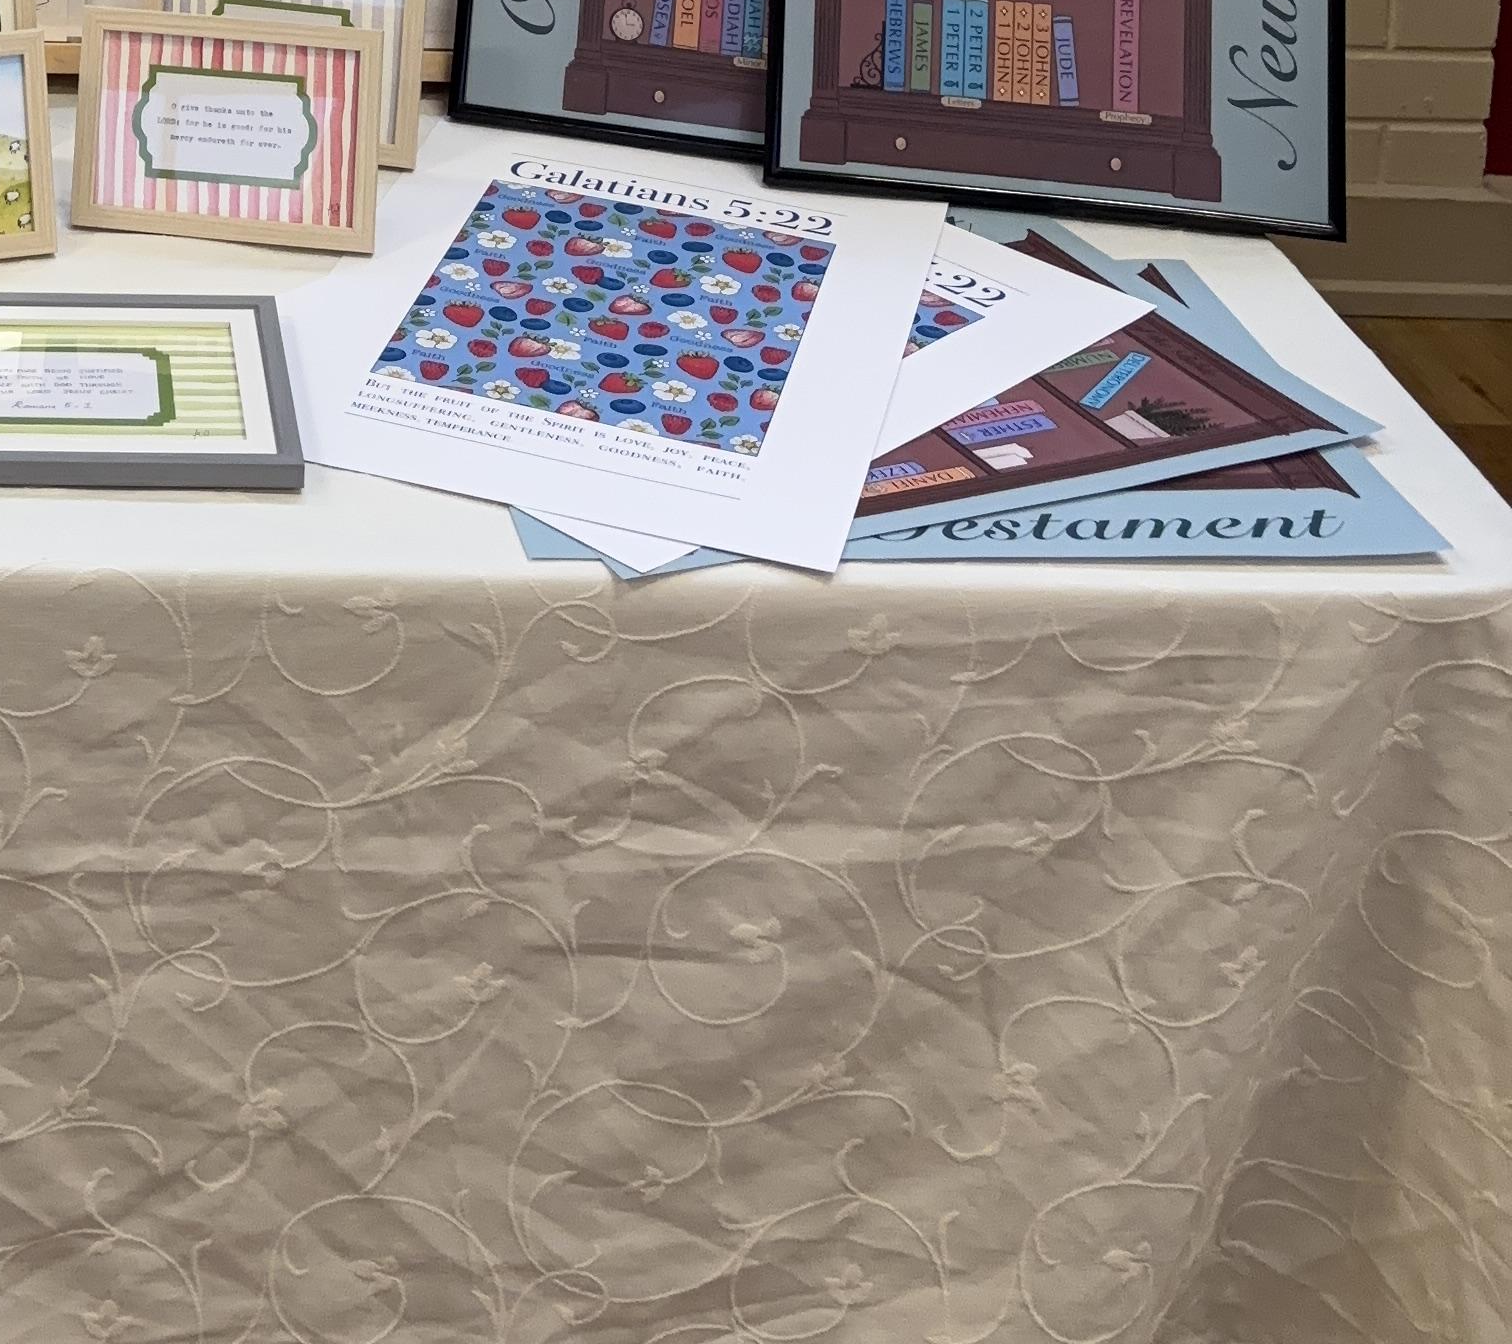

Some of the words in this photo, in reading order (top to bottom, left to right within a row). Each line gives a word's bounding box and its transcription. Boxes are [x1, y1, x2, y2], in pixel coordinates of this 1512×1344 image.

[914, 20, 930, 73] JAMES
[944, 23, 960, 72] PETER
[967, 25, 983, 74] PETER
[996, 36, 1012, 84] JOHN
[1014, 38, 1030, 87] JOHN
[1034, 39, 1050, 88] JOHN
[1055, 37, 1074, 81] JUDE
[509, 159, 711, 215] Galatians
[722, 197, 835, 238] 5:22
[982, 417, 1044, 439] ESTHER
